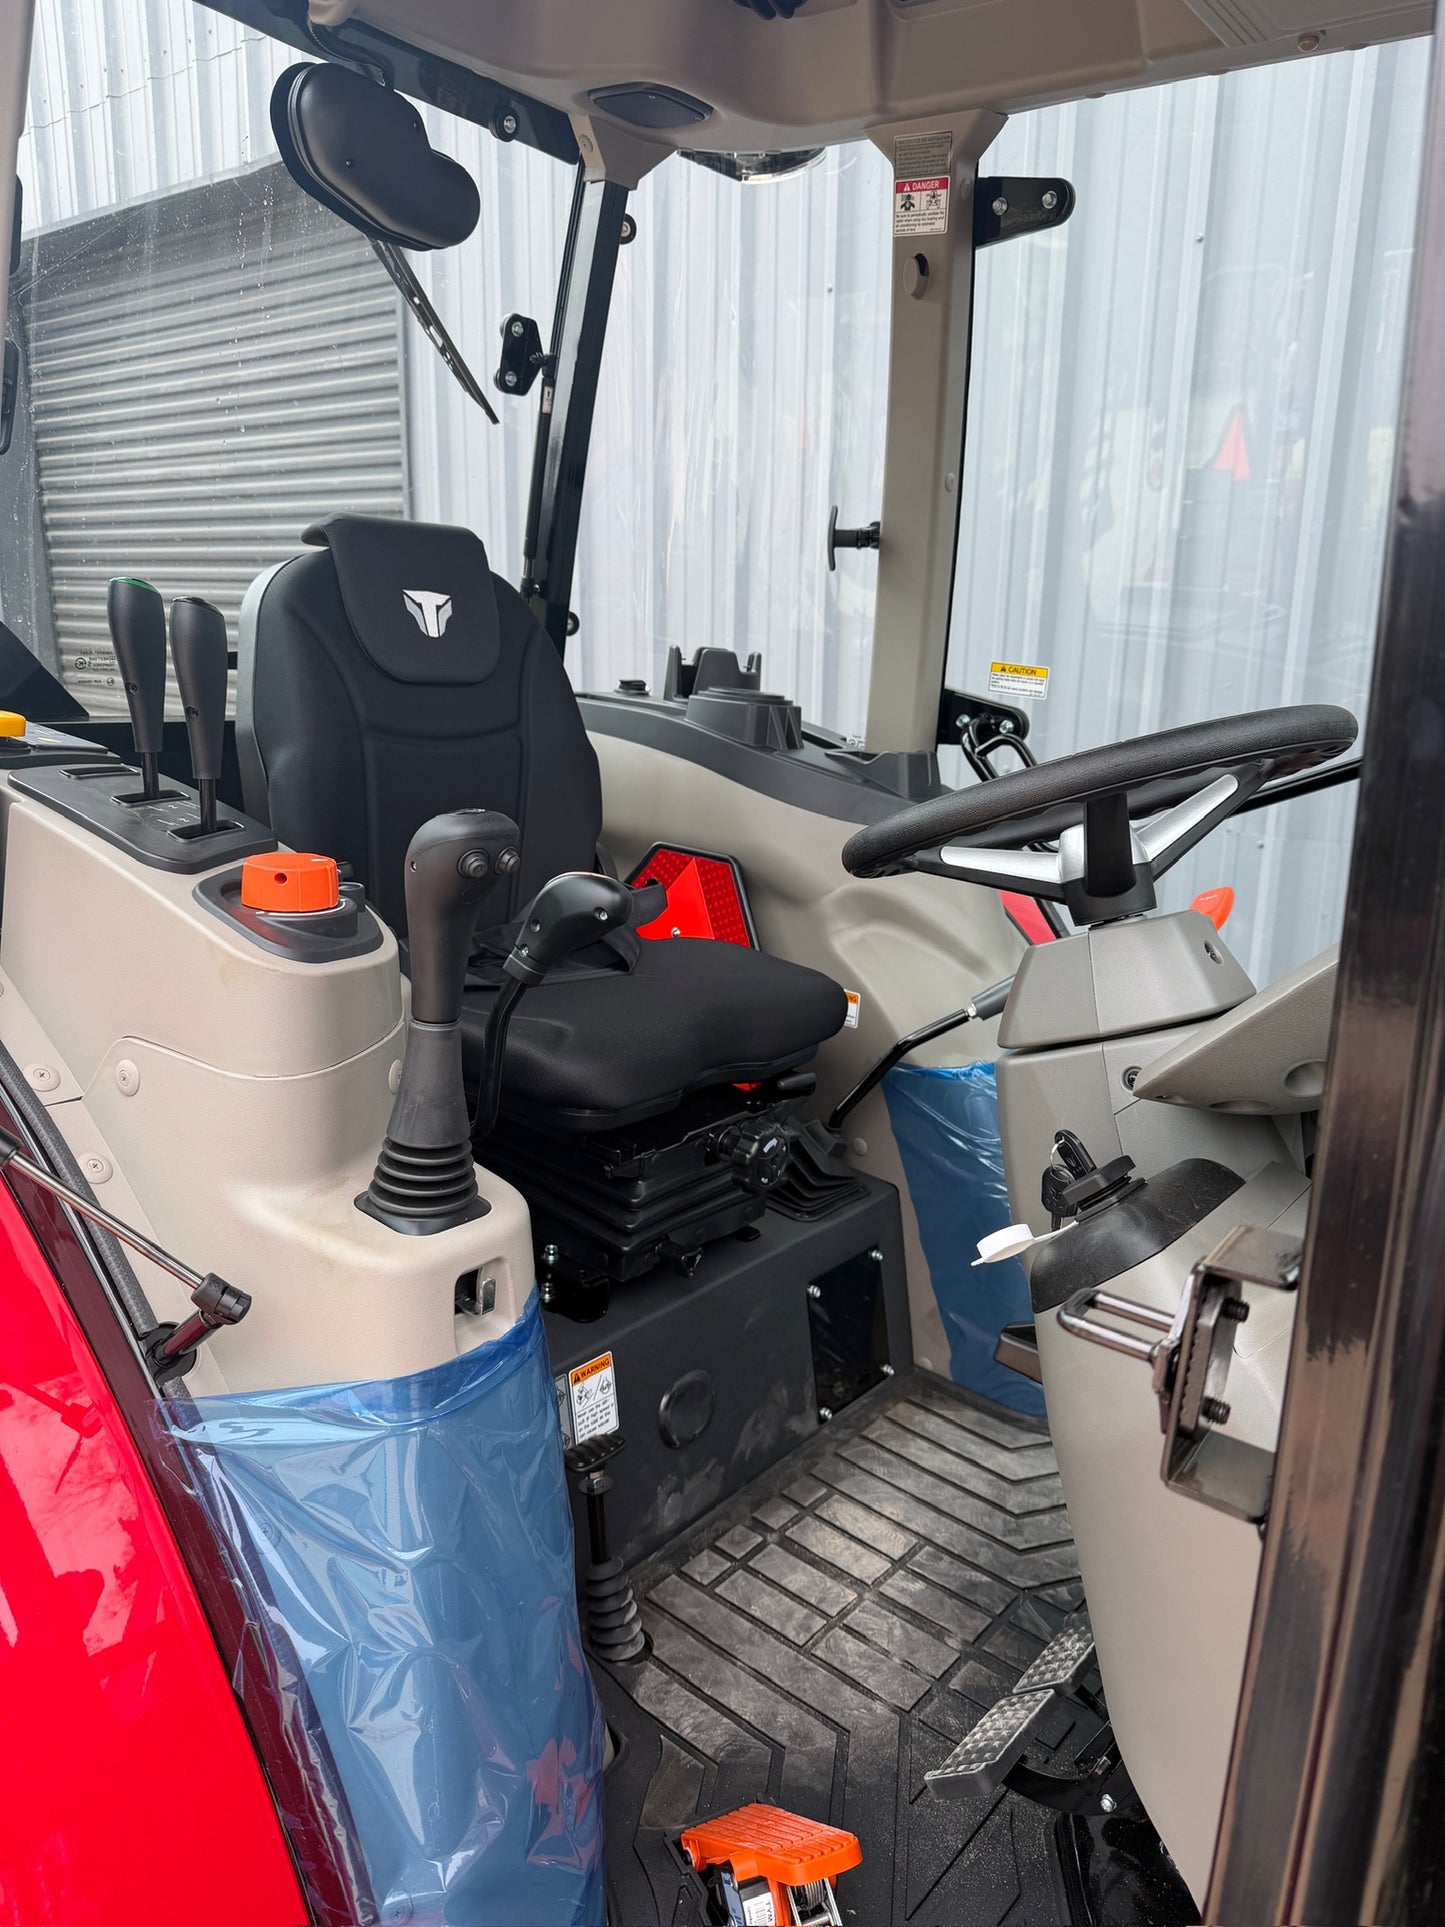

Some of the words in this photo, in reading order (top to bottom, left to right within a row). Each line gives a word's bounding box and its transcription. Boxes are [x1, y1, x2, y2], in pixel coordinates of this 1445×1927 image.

[912, 180, 939, 191] DANGER
[1008, 666, 1037, 676] CAUTION
[581, 1358, 610, 1378] WARNING
